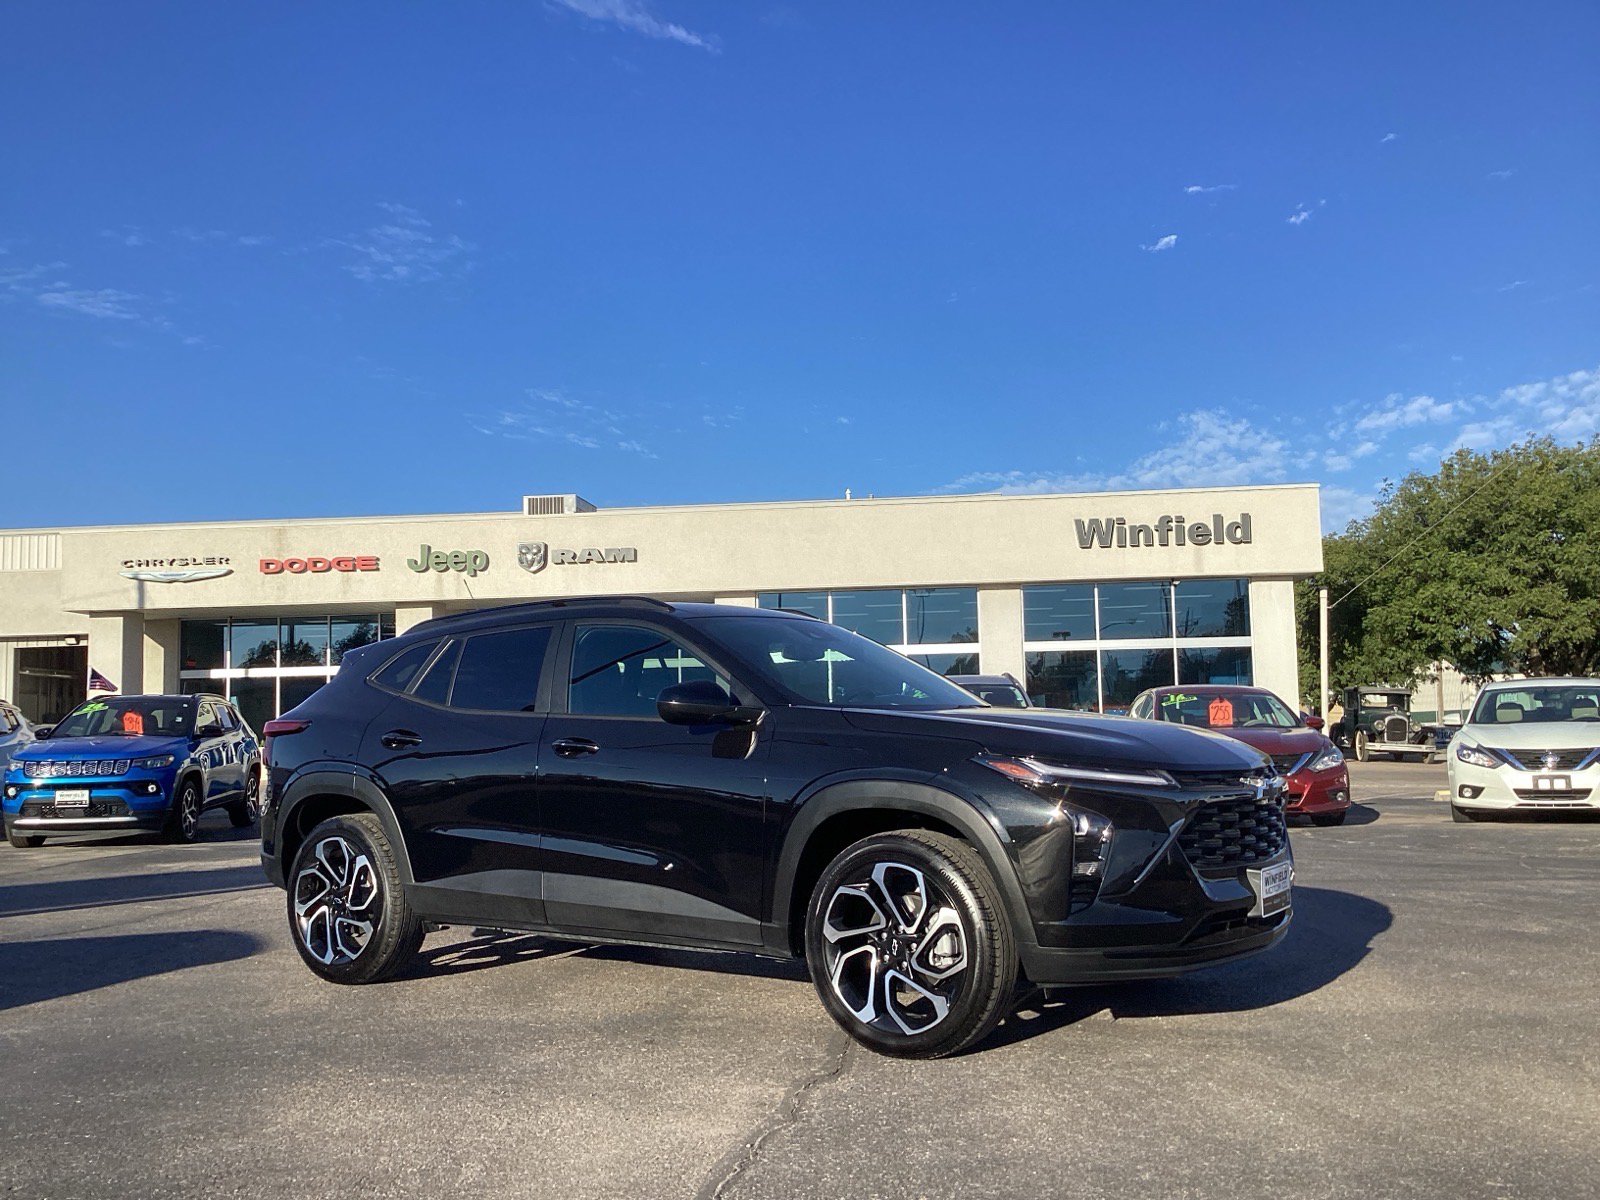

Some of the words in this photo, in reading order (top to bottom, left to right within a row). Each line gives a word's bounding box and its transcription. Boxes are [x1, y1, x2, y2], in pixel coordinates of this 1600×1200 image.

[1074, 513, 1252, 549] Winfield
[120, 556, 231, 569] CHRYSLER
[259, 555, 380, 574] DODGE
[406, 544, 489, 577] Jeep
[551, 547, 637, 564] RAM
[1264, 869, 1288, 887] WINFIELD
